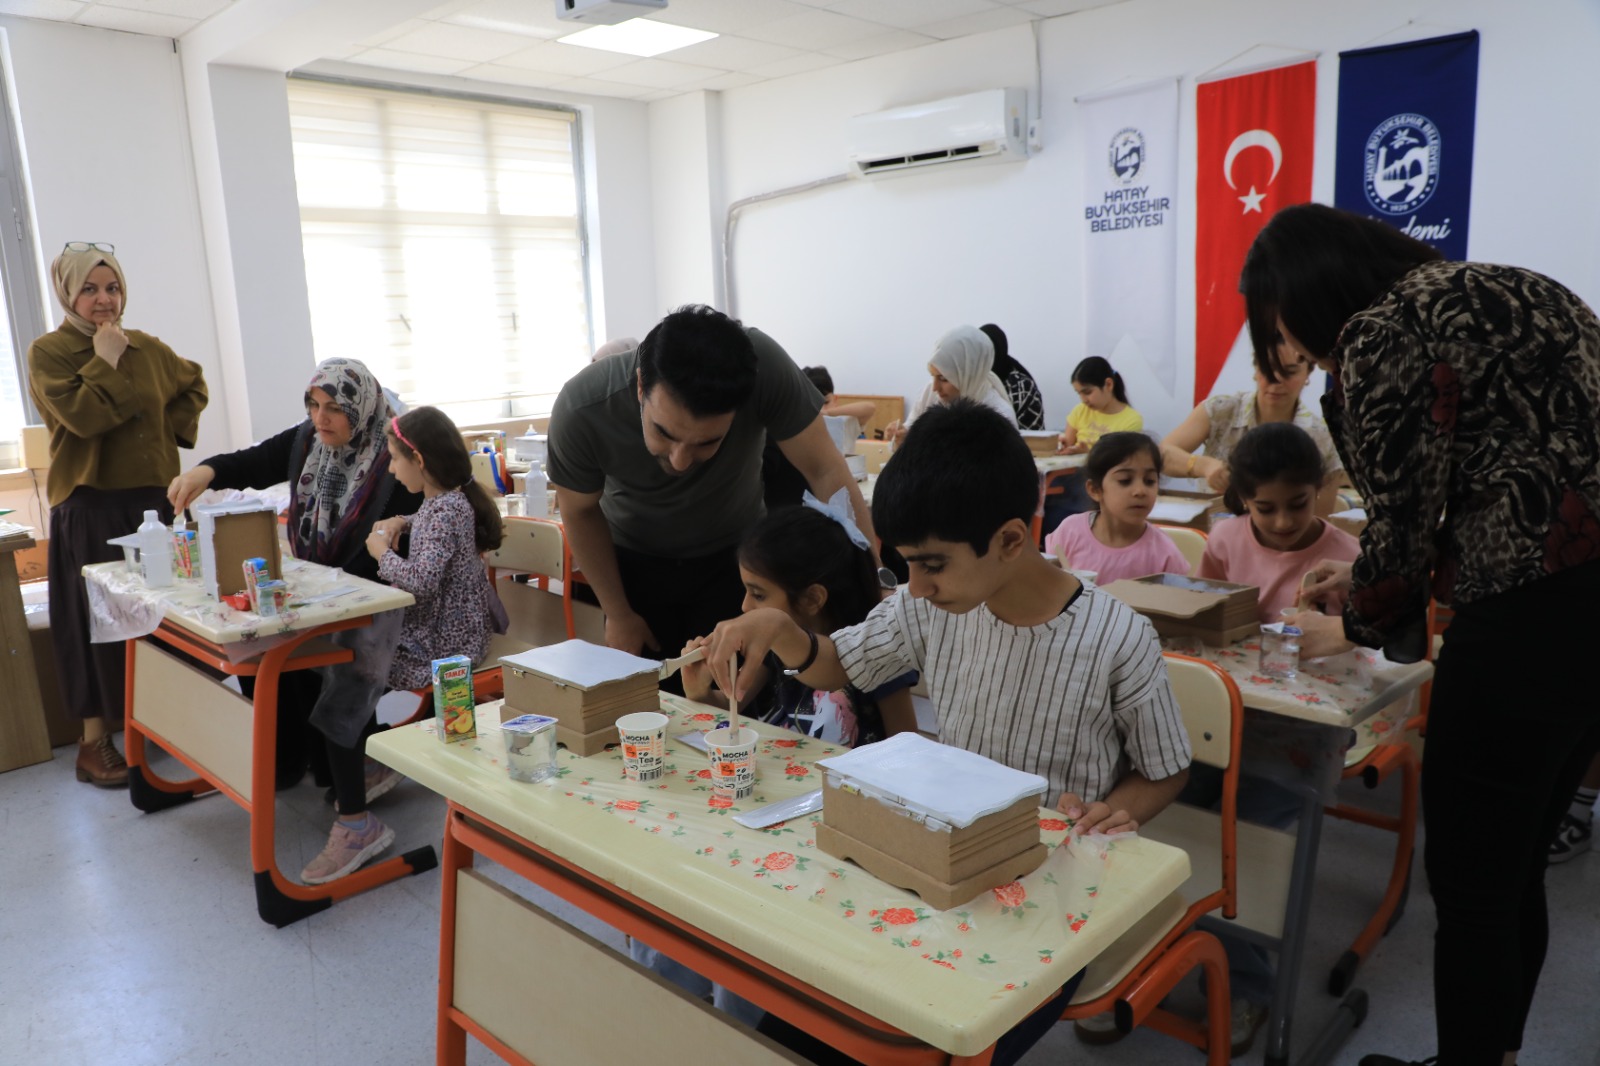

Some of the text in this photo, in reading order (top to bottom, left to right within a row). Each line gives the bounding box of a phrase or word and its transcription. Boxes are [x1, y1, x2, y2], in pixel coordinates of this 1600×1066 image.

[1105, 185, 1149, 203] HATAY
[444, 667, 466, 679] TAMEK
[722, 750, 748, 758] MOCHA
[736, 772, 751, 781] Tea
